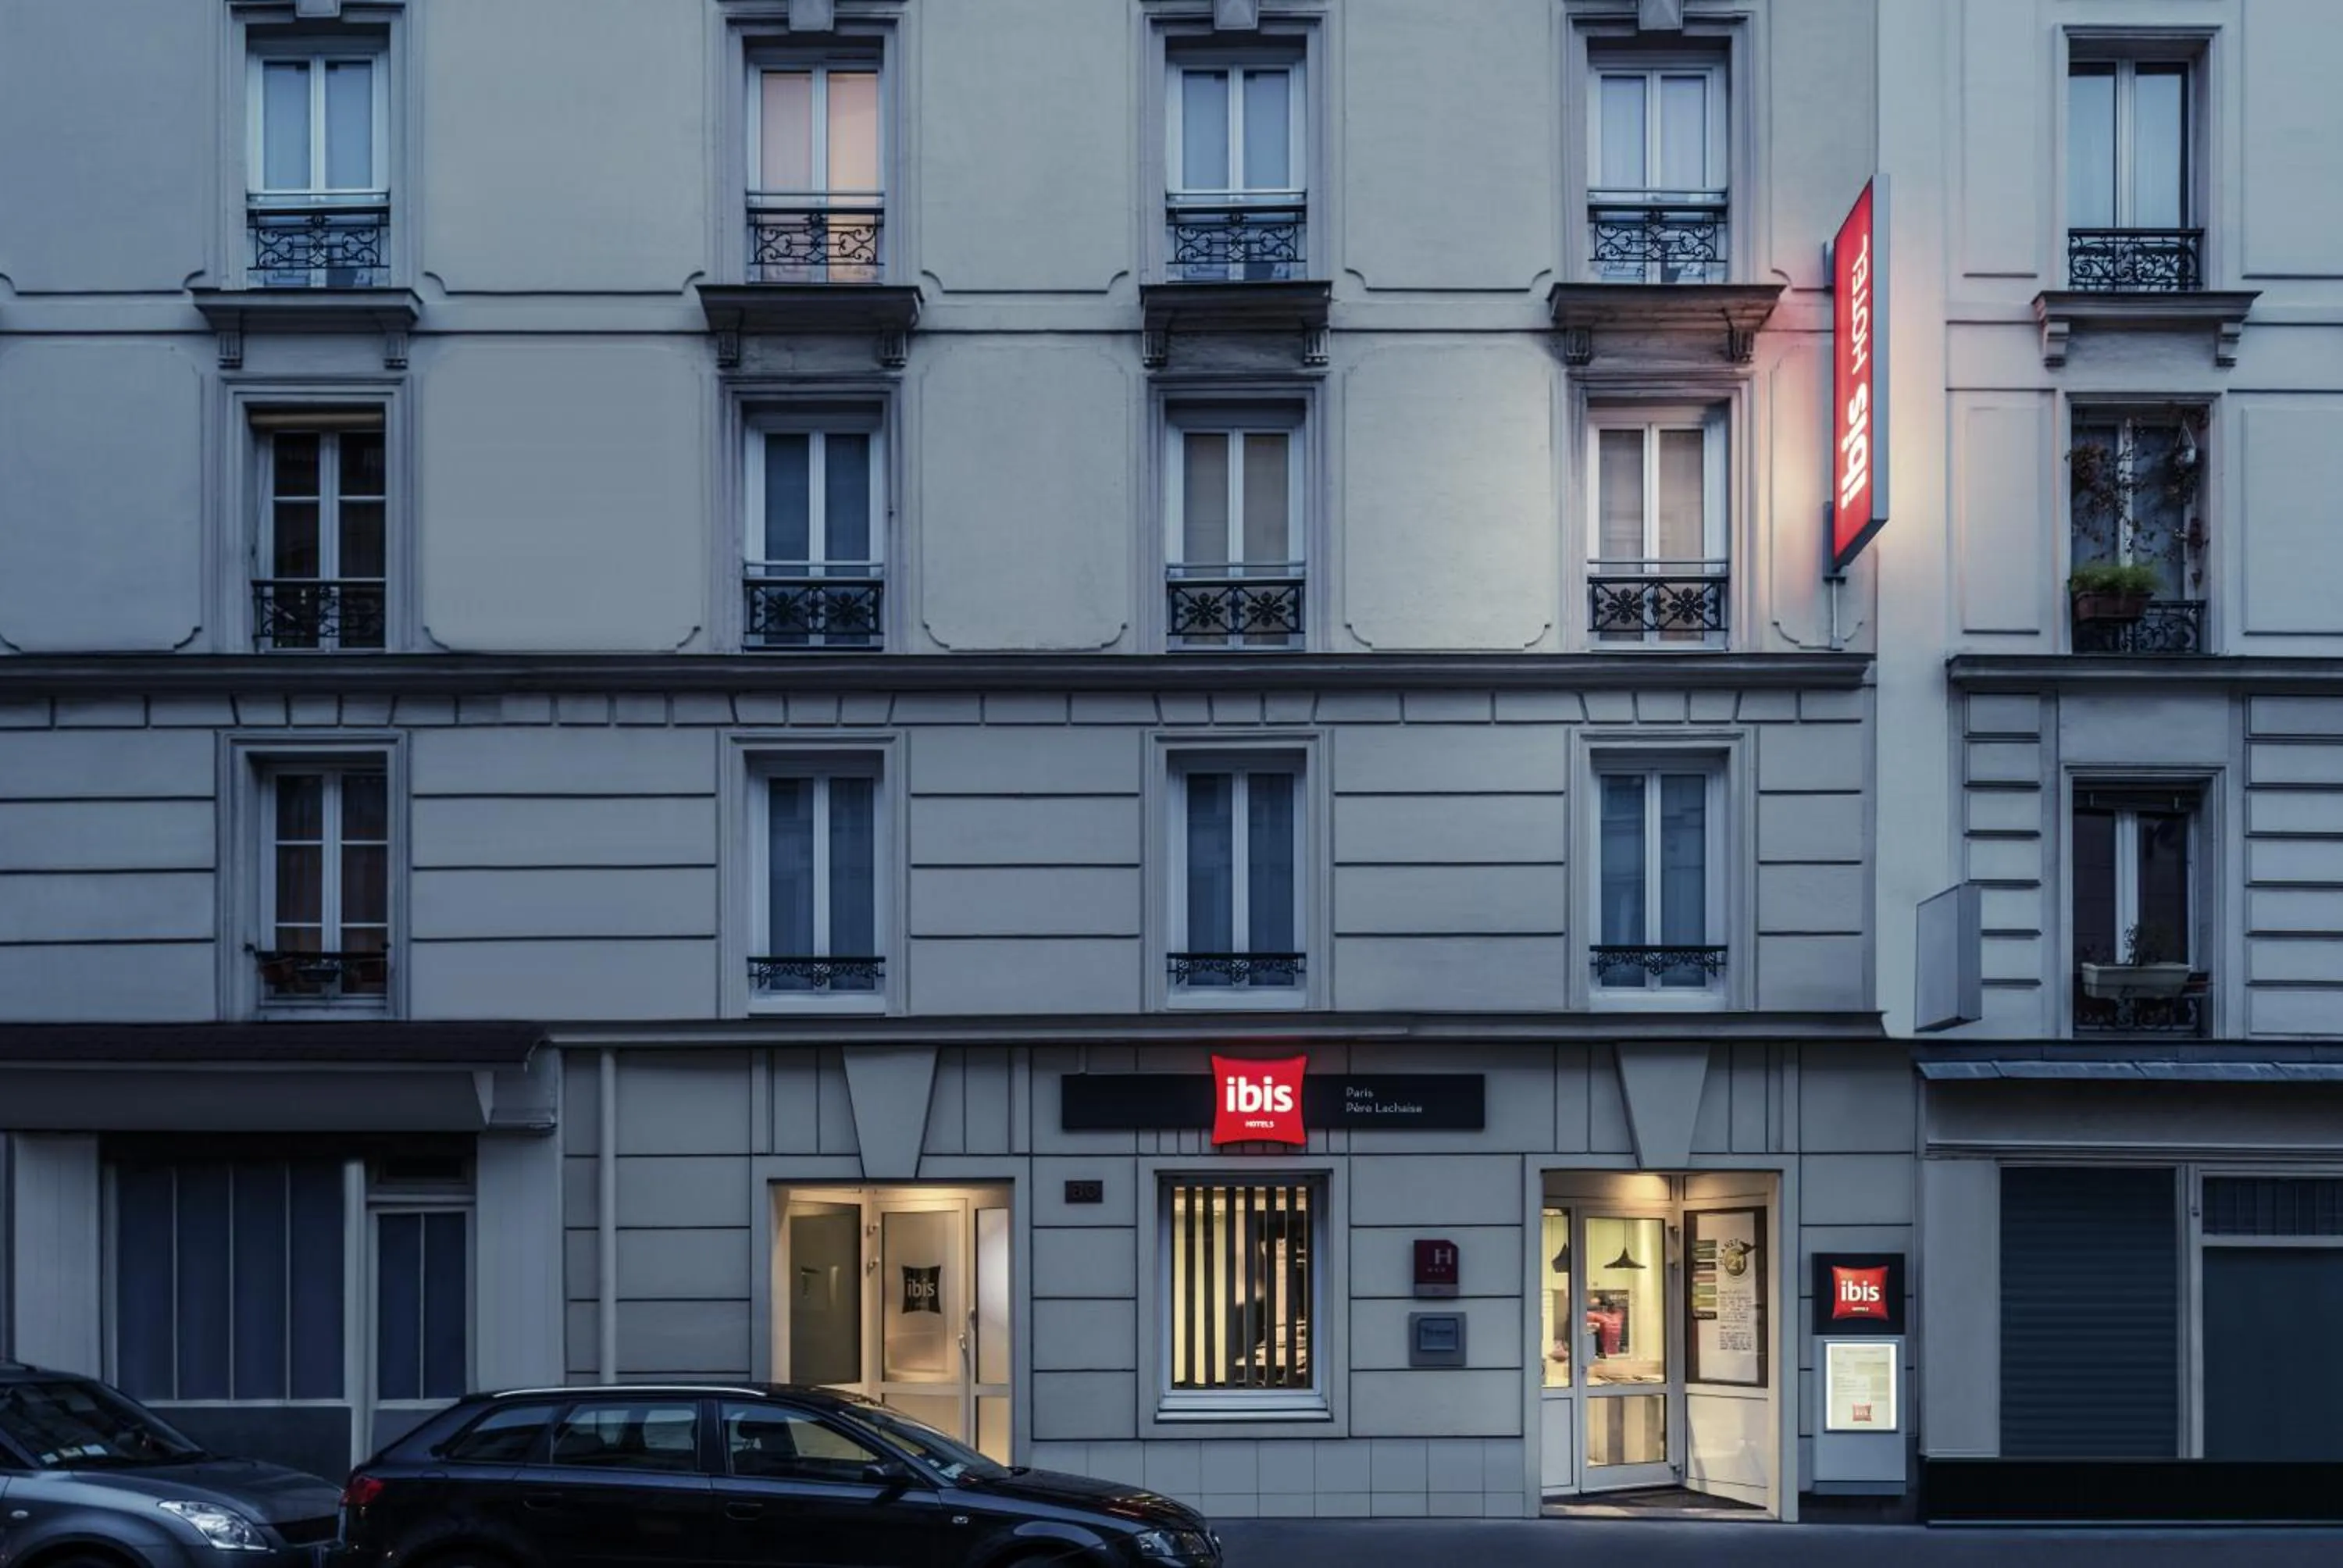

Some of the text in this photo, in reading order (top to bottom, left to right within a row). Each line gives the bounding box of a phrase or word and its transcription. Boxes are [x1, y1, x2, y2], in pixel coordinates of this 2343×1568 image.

[1841, 234, 1868, 510] ibis HOTEL
[1225, 1075, 1293, 1113] ibis
[1346, 1086, 1374, 1098] Paris
[1346, 1101, 1422, 1114] Père Lachaise
[1244, 1121, 1275, 1129] HOTELS
[1434, 1248, 1453, 1265] H
[908, 1278, 935, 1298] ibis
[1840, 1280, 1880, 1302] ibis
